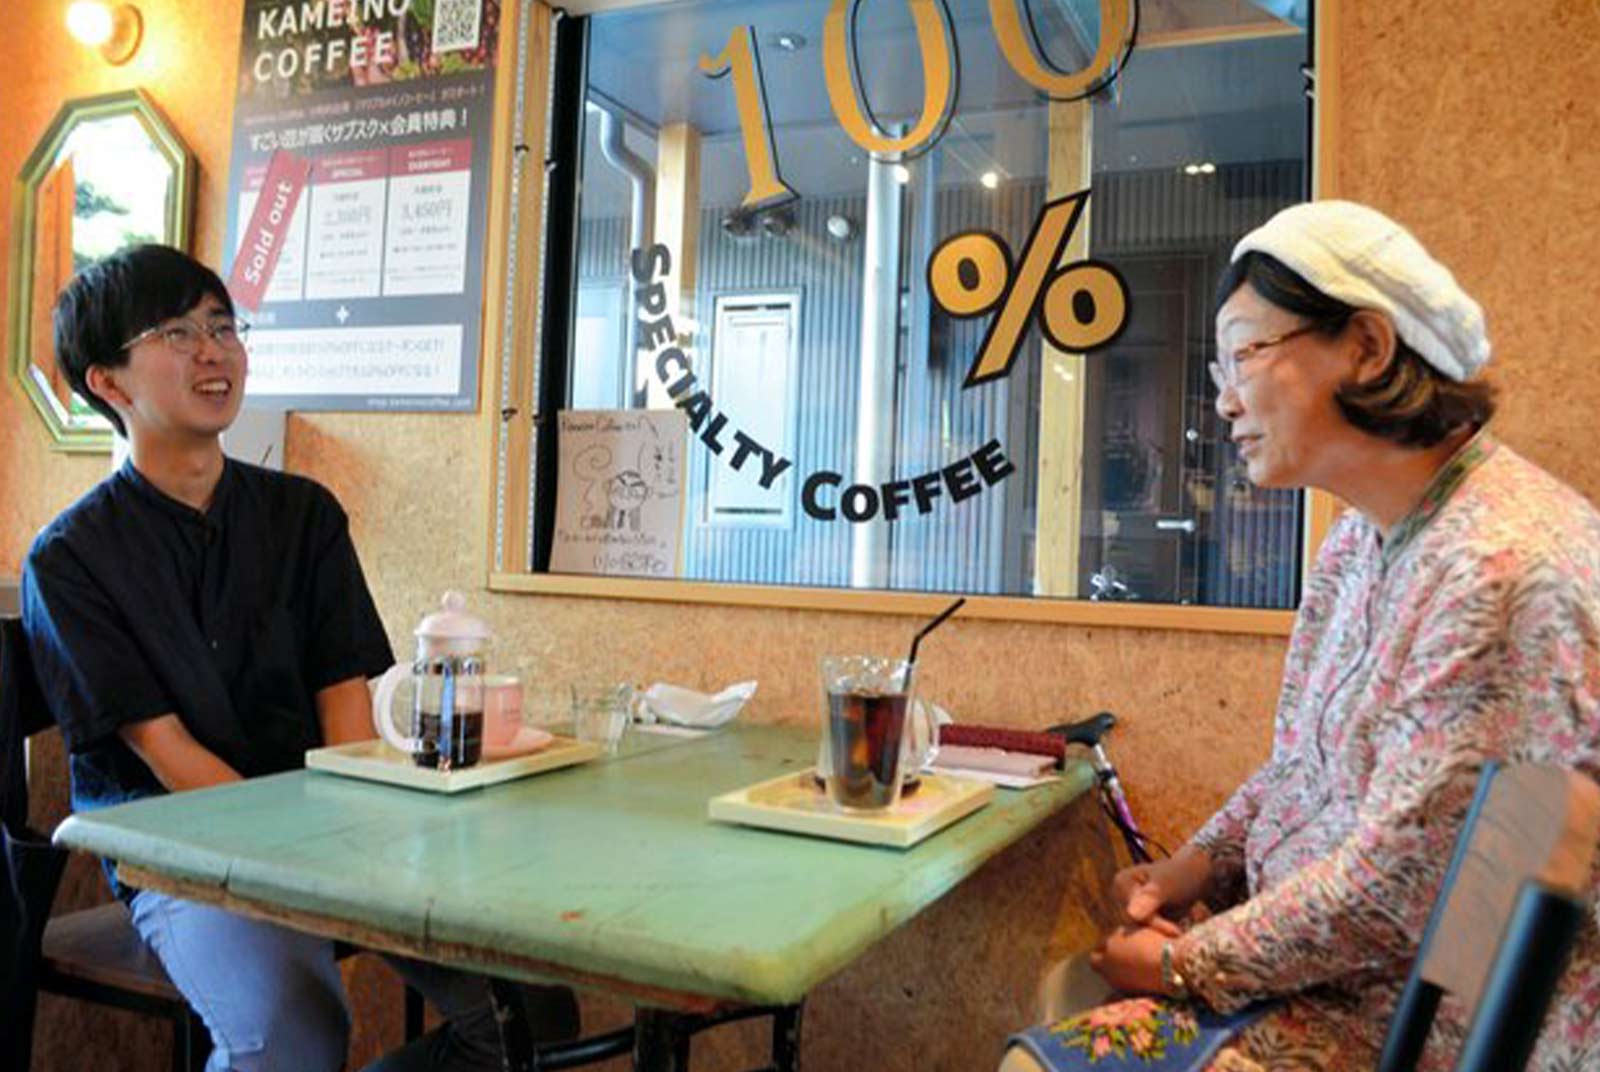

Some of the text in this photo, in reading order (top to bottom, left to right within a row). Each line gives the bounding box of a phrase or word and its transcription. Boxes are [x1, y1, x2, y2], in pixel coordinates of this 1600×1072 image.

[254, 32, 394, 82] COFFEE
[257, 0, 409, 39] KAMEINO
[244, 228, 275, 286] Sold
[269, 177, 293, 225] out
[630, 243, 1017, 523] SPECIALTY COFFEE
